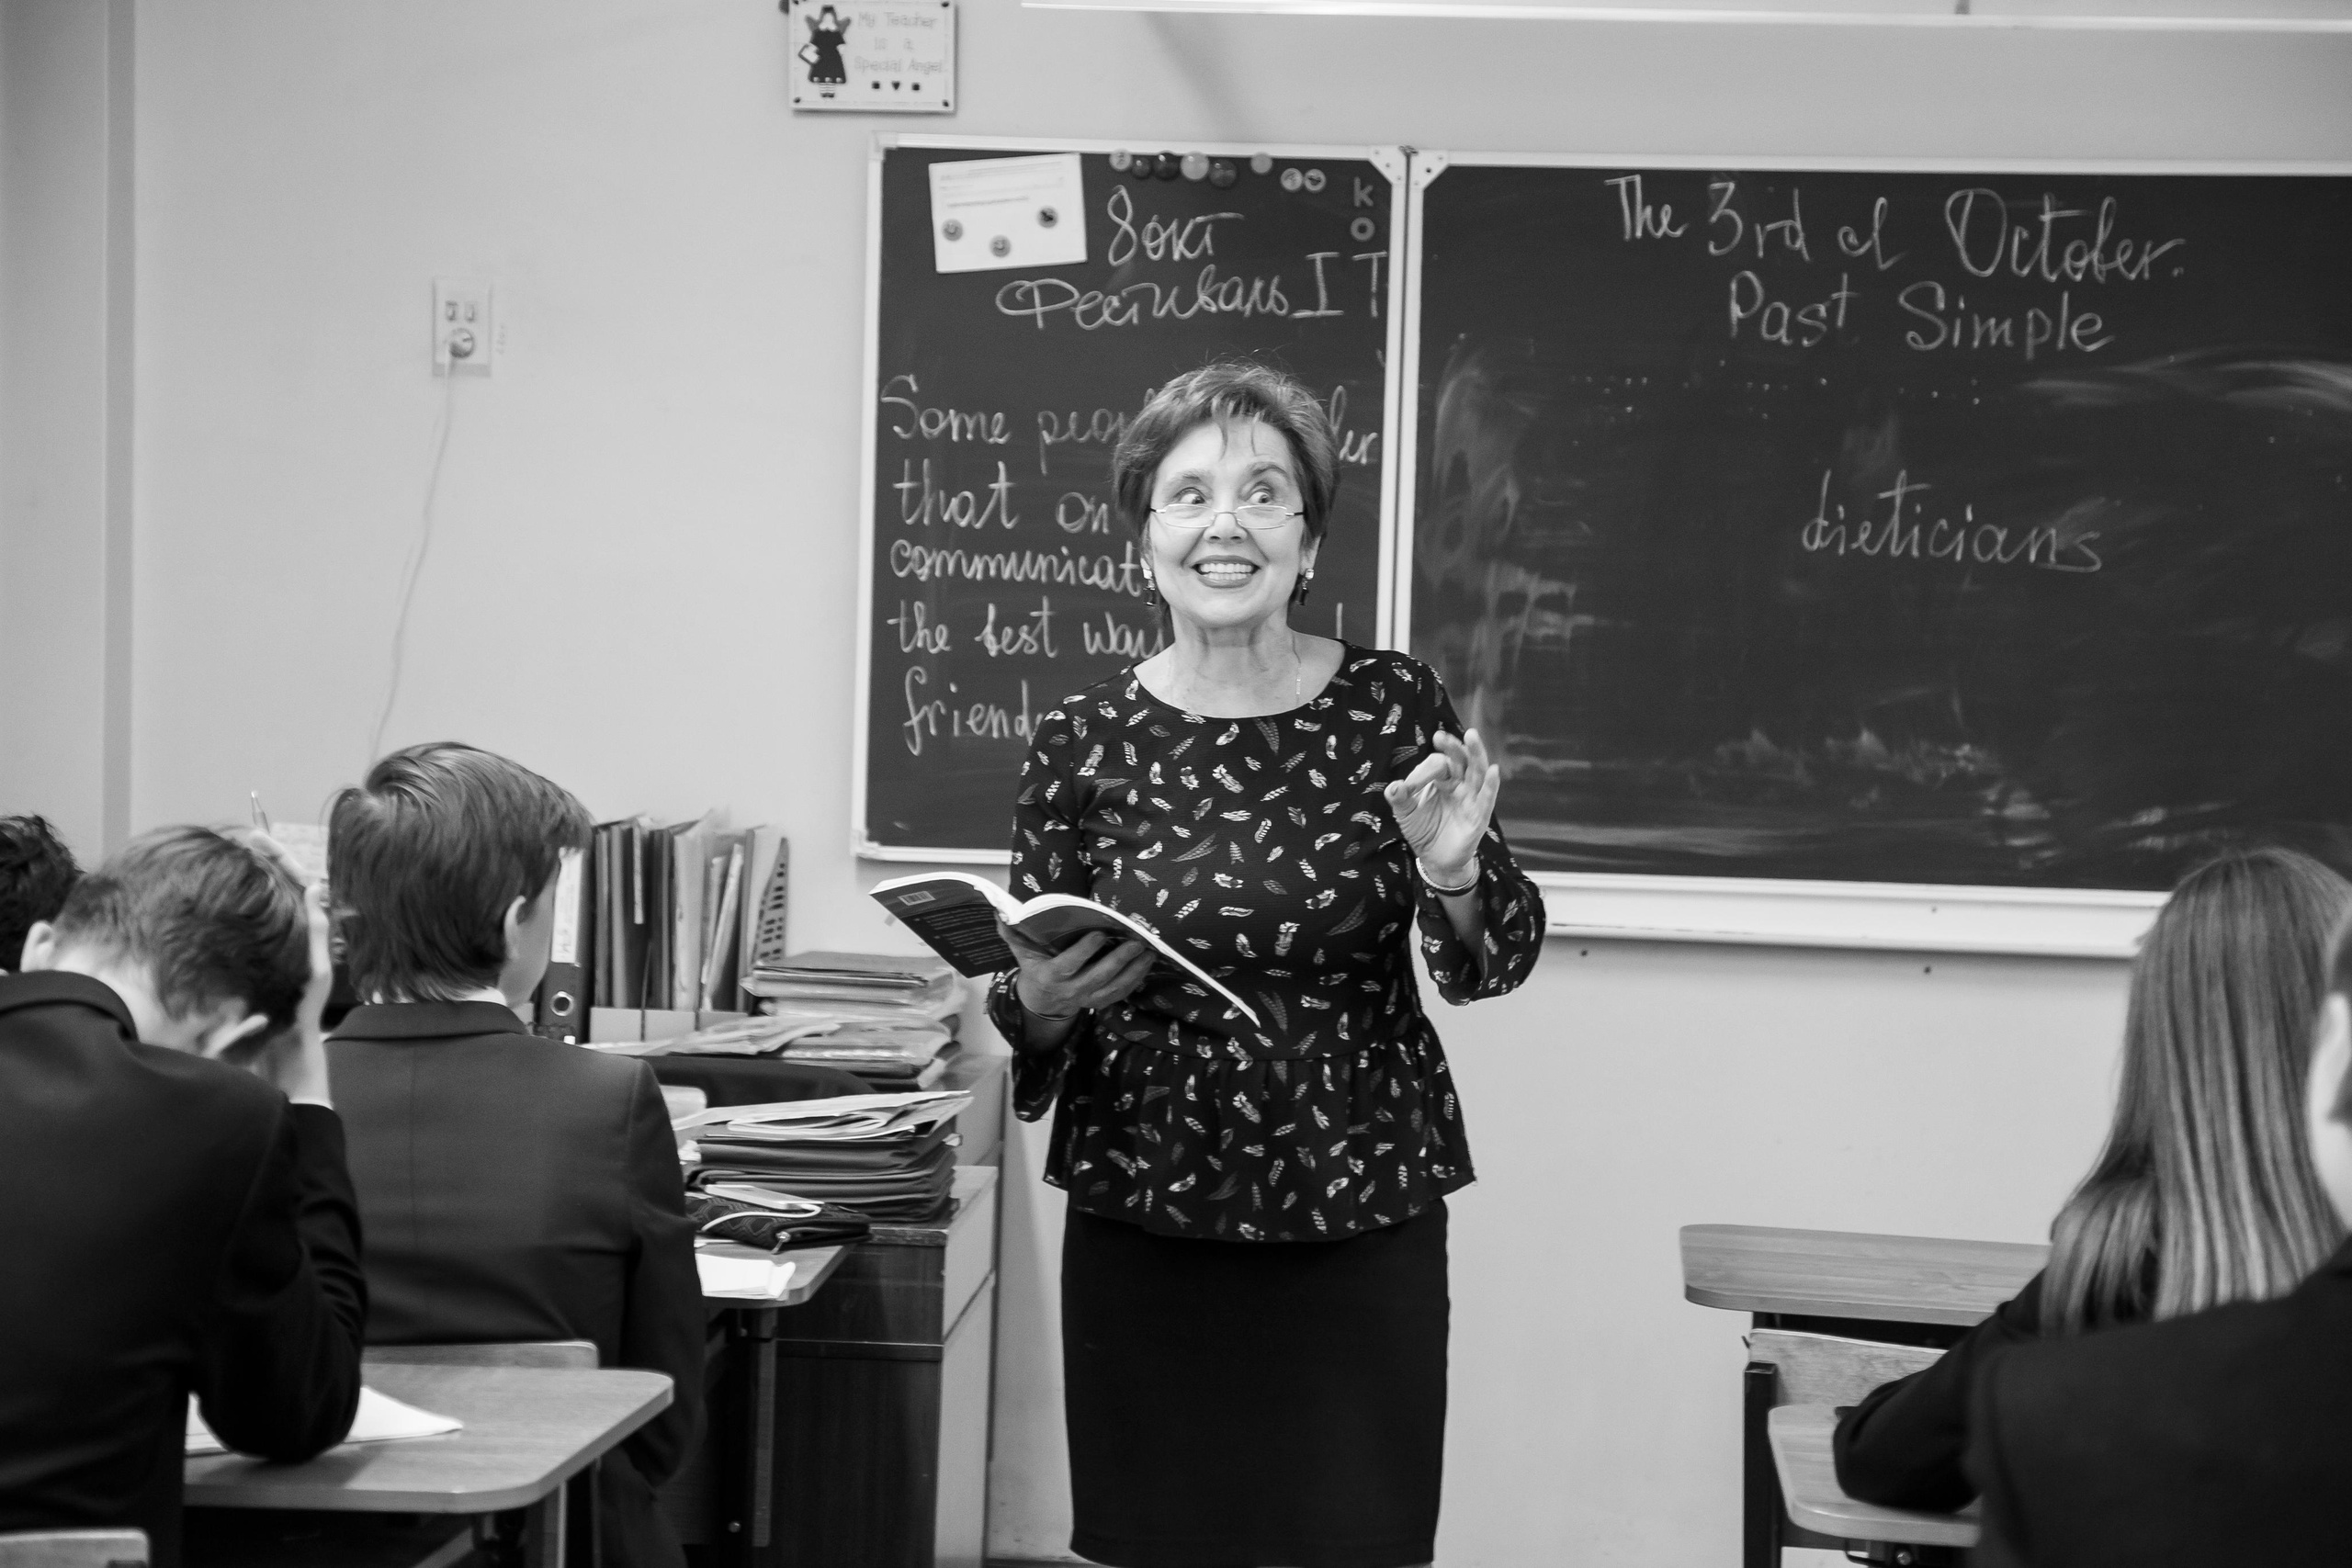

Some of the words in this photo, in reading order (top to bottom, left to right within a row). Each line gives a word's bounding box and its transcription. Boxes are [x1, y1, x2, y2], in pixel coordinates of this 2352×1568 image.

[883, 11, 938, 29] Teacher
[854, 55, 902, 75] Special
[907, 56, 944, 76] Angel
[1604, 173, 1690, 242] The
[1707, 180, 1814, 262] 3rd
[1728, 270, 1860, 348] Past
[1897, 279, 2115, 360] Simple
[880, 373, 1012, 446] Some
[893, 457, 1019, 530] that
[1801, 468, 2103, 572] dieticians
[886, 600, 952, 654] the
[974, 595, 1058, 659] best
